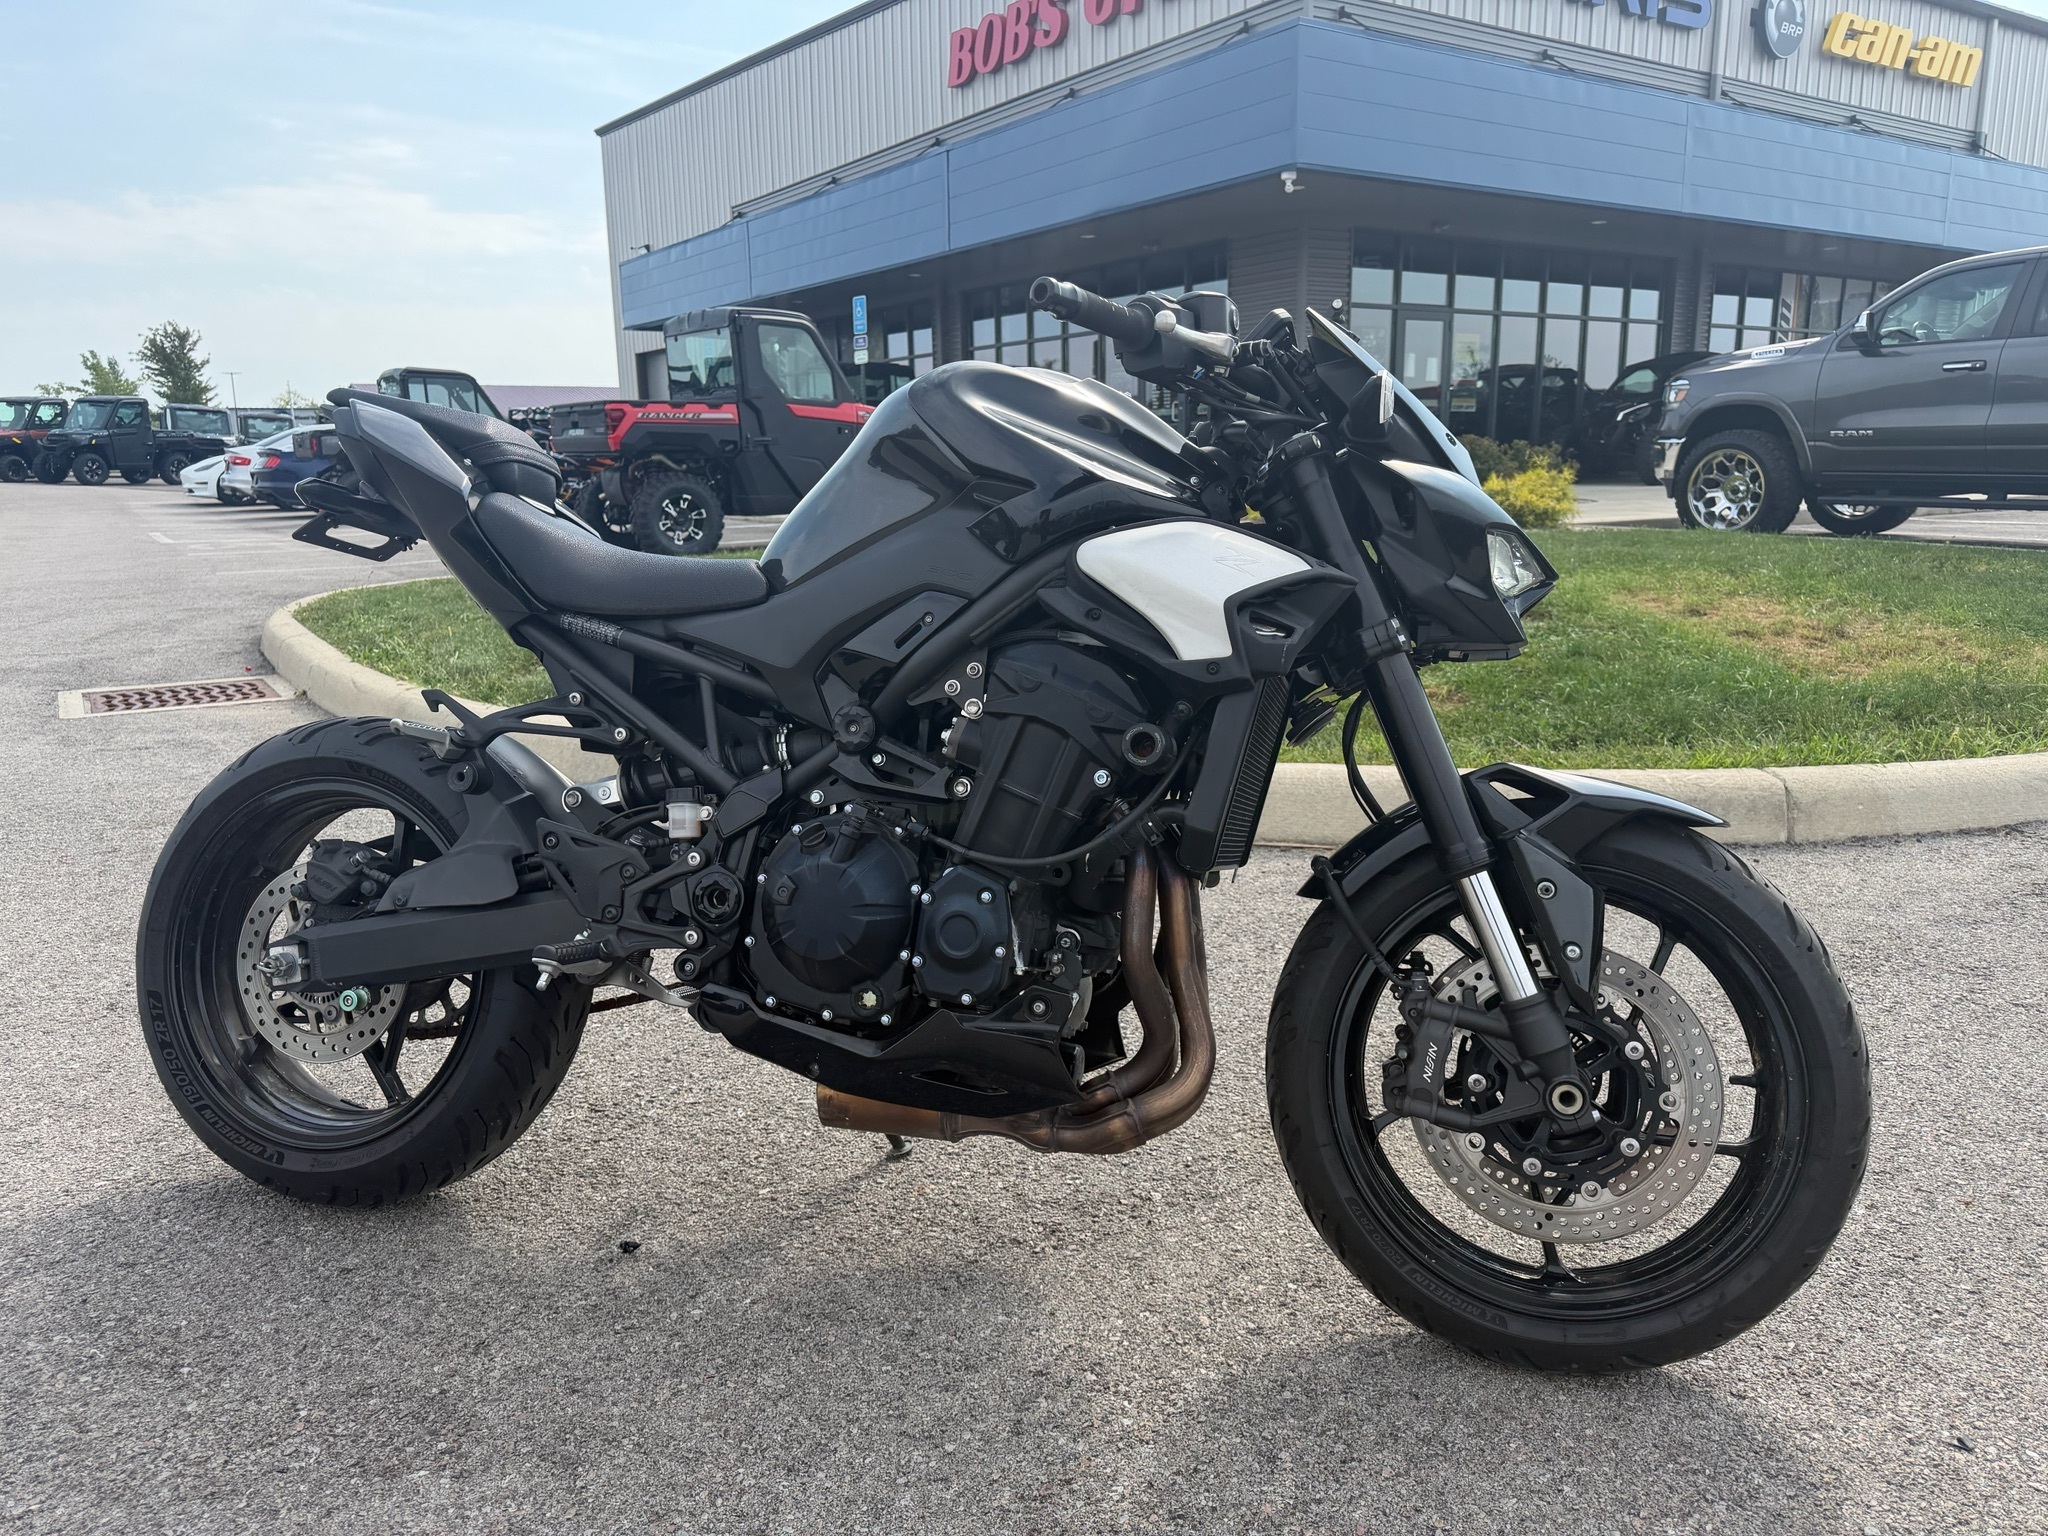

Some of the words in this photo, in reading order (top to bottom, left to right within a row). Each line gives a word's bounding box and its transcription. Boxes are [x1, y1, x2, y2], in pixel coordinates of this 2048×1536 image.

[948, 0, 1067, 88] BOB'S
[1781, 21, 1803, 37] BRP
[150, 998, 164, 1016] 17
[154, 1020, 172, 1043] ZR
[163, 1048, 200, 1102] 190/50
[201, 1108, 264, 1155] MICHELIN
[1372, 1233, 1404, 1265] 120/70
[1412, 1272, 1481, 1315] MICHELIN
